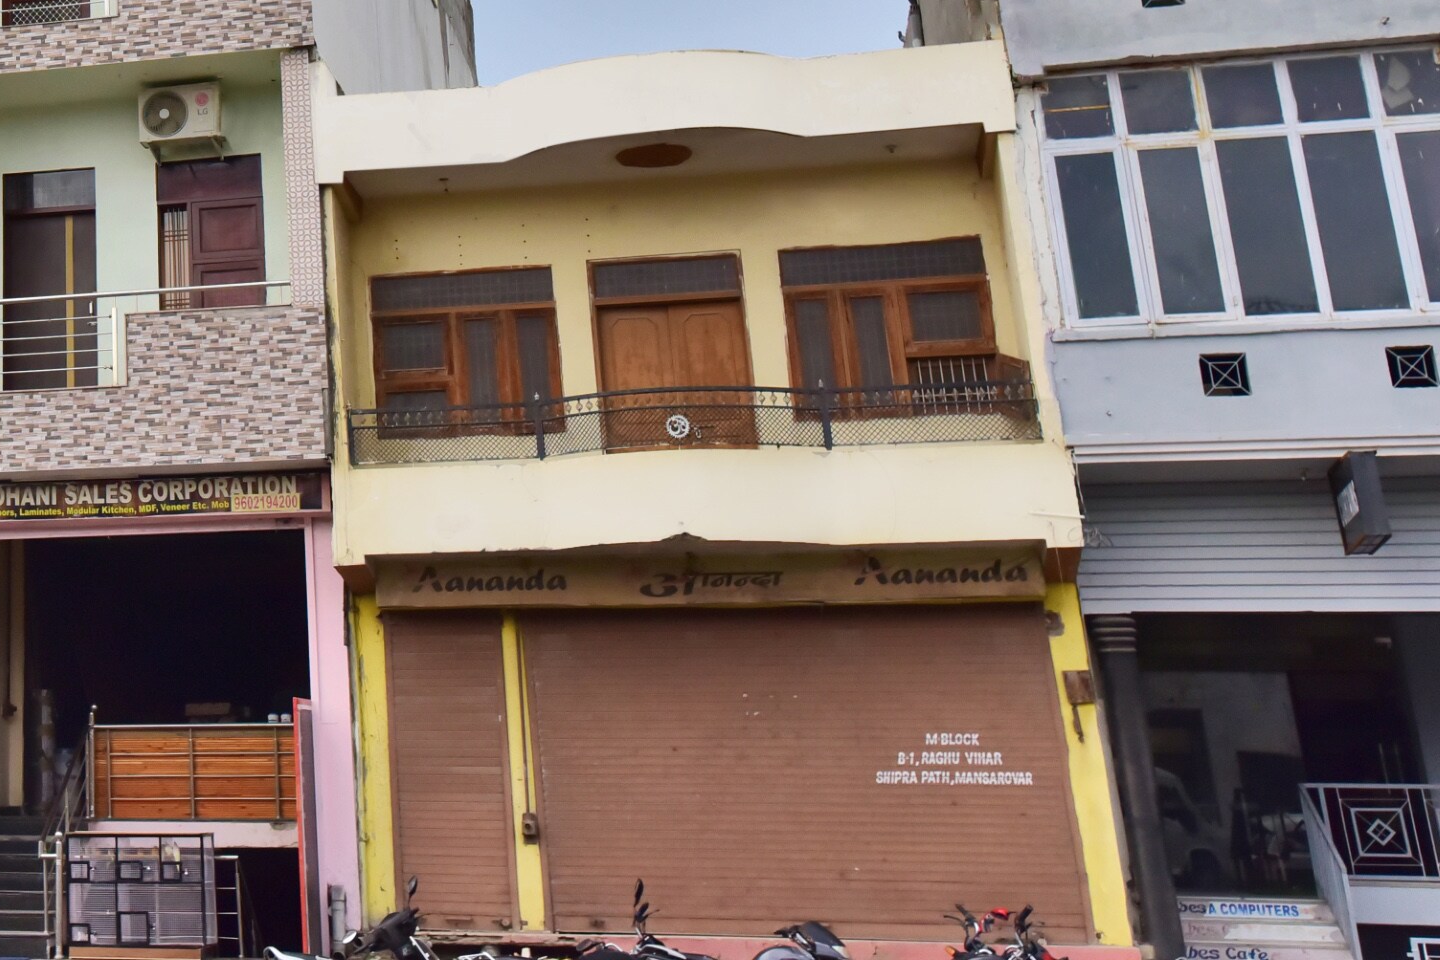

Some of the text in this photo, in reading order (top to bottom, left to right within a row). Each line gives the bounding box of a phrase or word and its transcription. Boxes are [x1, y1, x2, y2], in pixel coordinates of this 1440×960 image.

[197, 107, 209, 116] LG
[64, 482, 133, 506] SALES
[138, 475, 298, 504] CORPORATION
[19, 507, 65, 517] Laminates,
[66, 506, 100, 516] Modular
[101, 504, 137, 515] Kitchen,
[138, 504, 159, 514] MDF,
[160, 503, 190, 512] Veneer
[192, 501, 210, 511] Etc.
[211, 500, 230, 510] Mob
[234, 495, 299, 510] 9602194200
[854, 556, 1028, 586] Aananda
[412, 566, 568, 593] Aananda
[921, 751, 960, 765] RAGHU
[965, 751, 1003, 766] VIHAR
[875, 770, 918, 785] SHIPRA
[1220, 903, 1300, 917] COMPUTERS
[1225, 947, 1269, 960] Cafe
